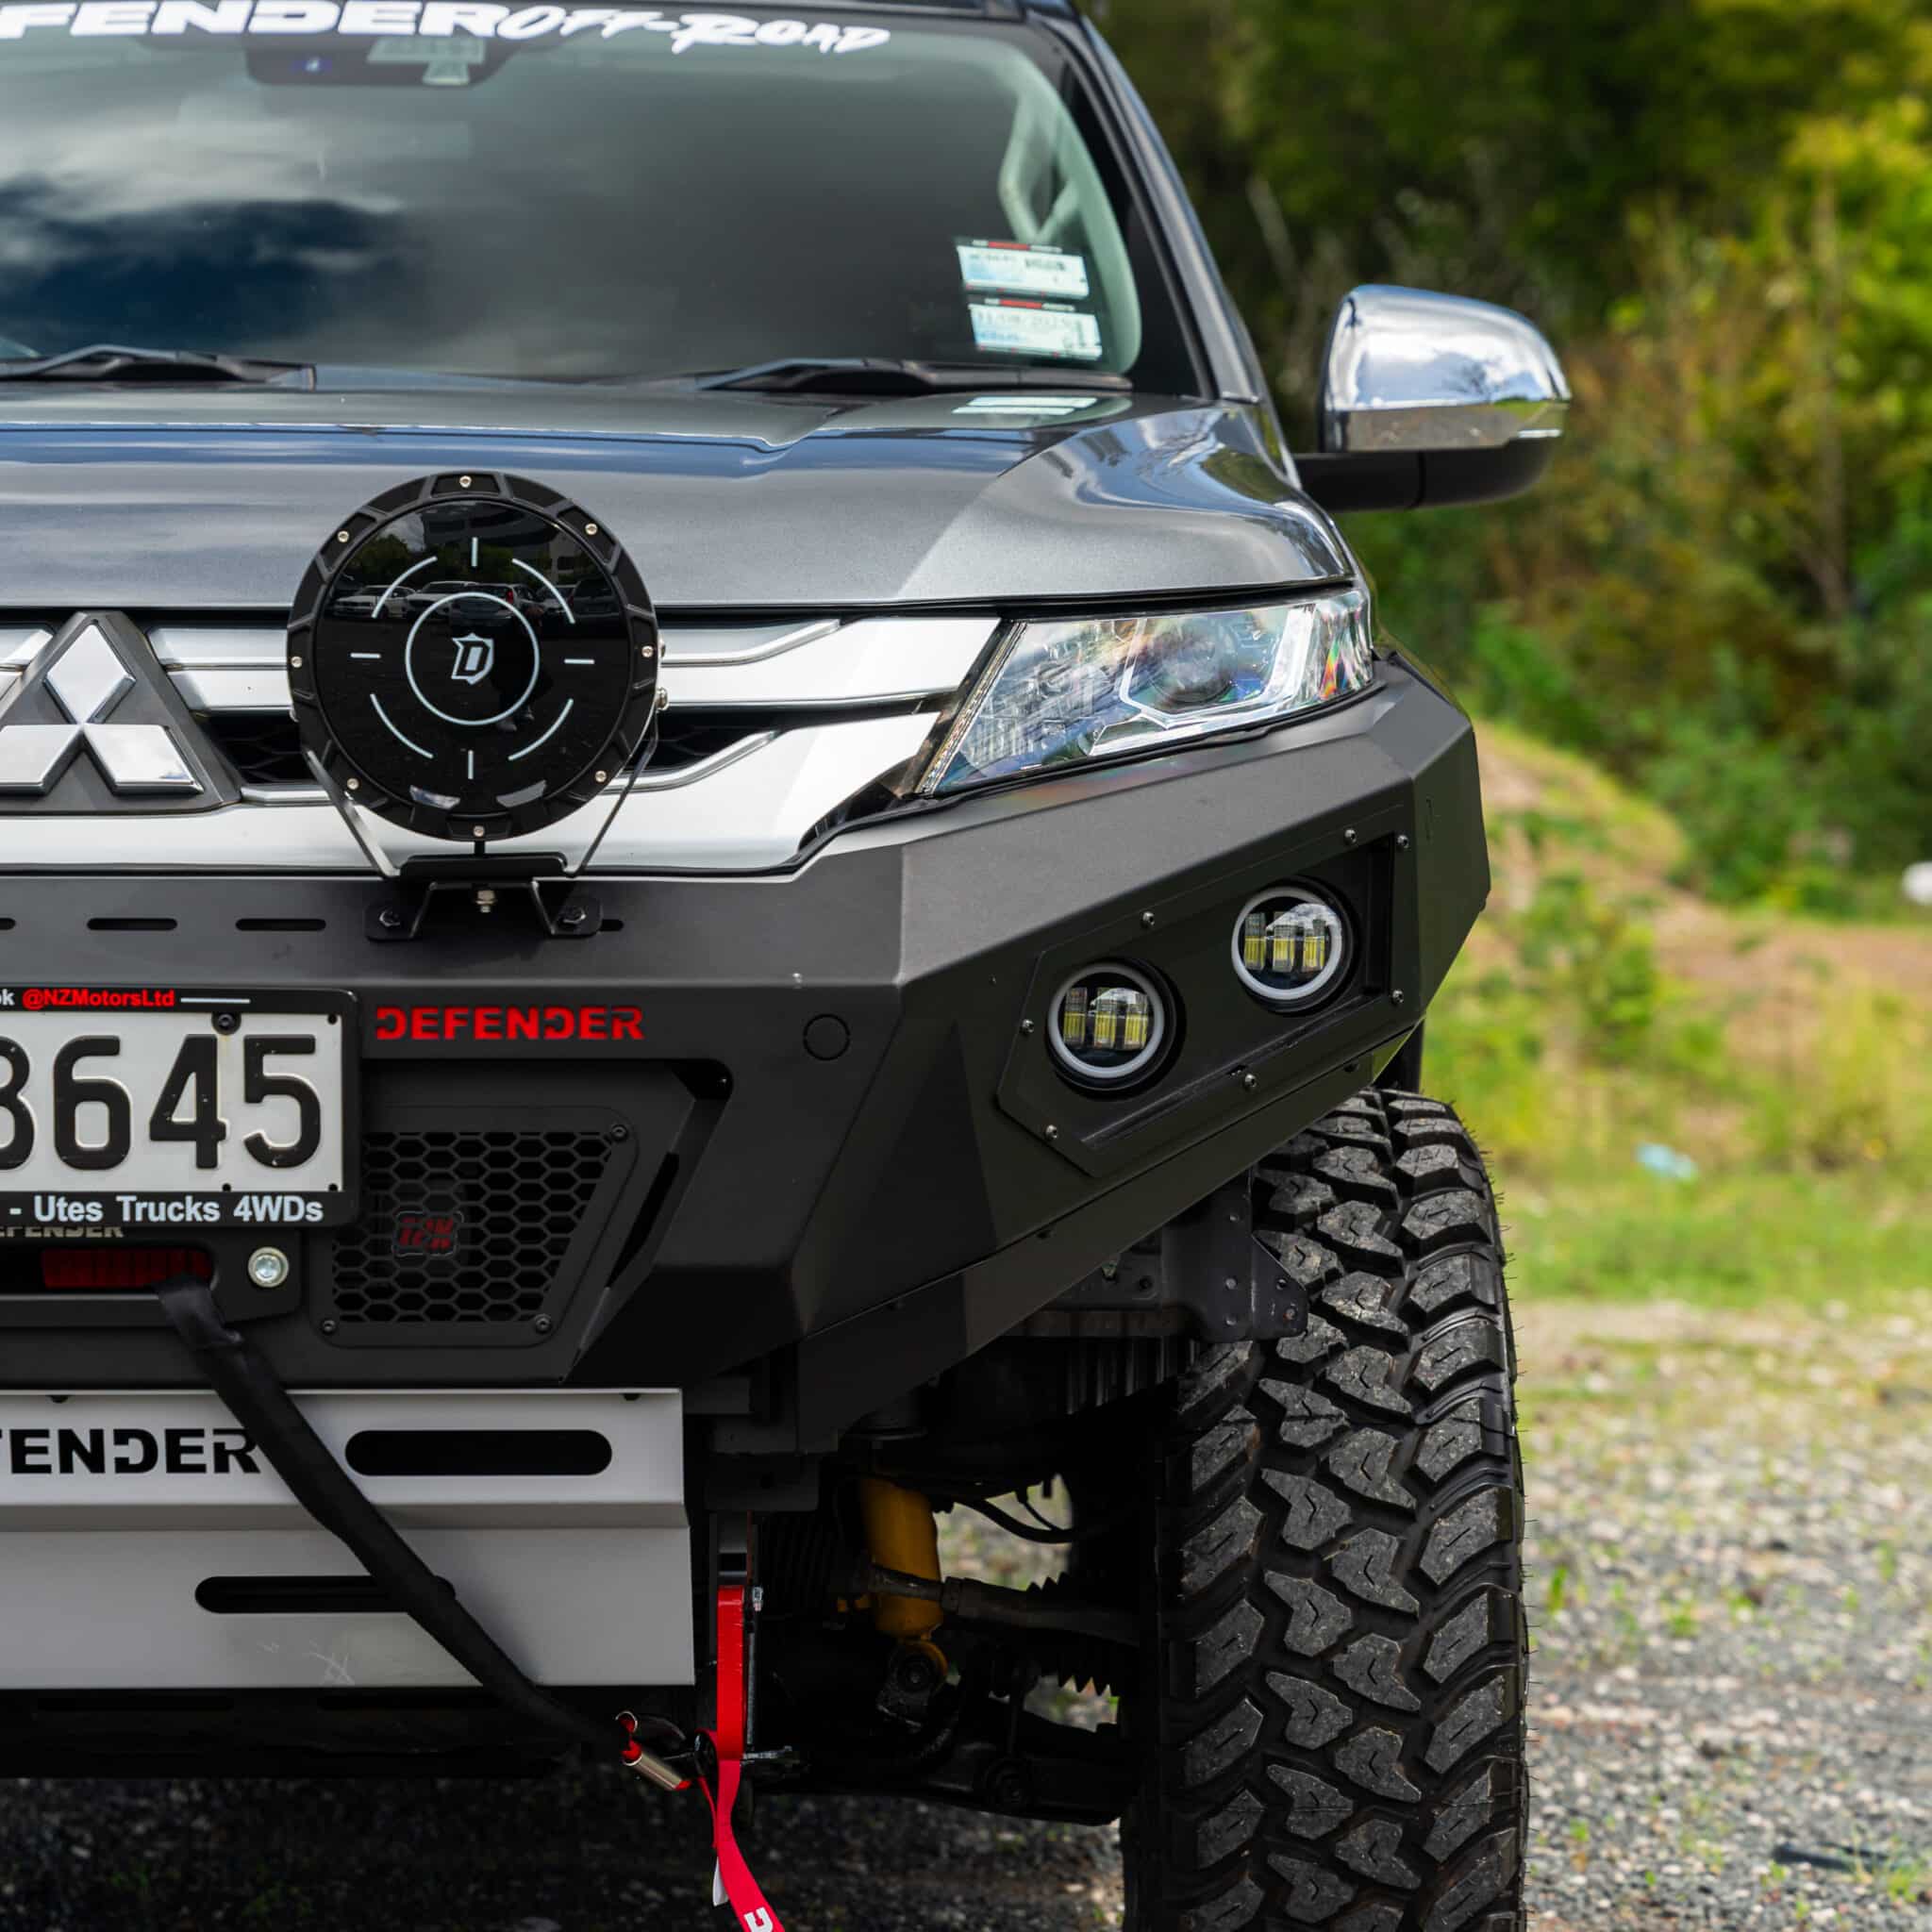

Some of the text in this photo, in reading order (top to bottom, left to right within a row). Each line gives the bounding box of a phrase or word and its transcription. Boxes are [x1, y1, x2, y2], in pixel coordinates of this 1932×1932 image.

[0, 988, 176, 1011] k @NZMotorsLtd
[375, 1007, 645, 1041] DEFENDER
[34, 1194, 104, 1223] Utes
[115, 1194, 221, 1223] Trucks
[233, 1194, 324, 1223] 4WDs
[0, 1428, 261, 1474] ENDER
